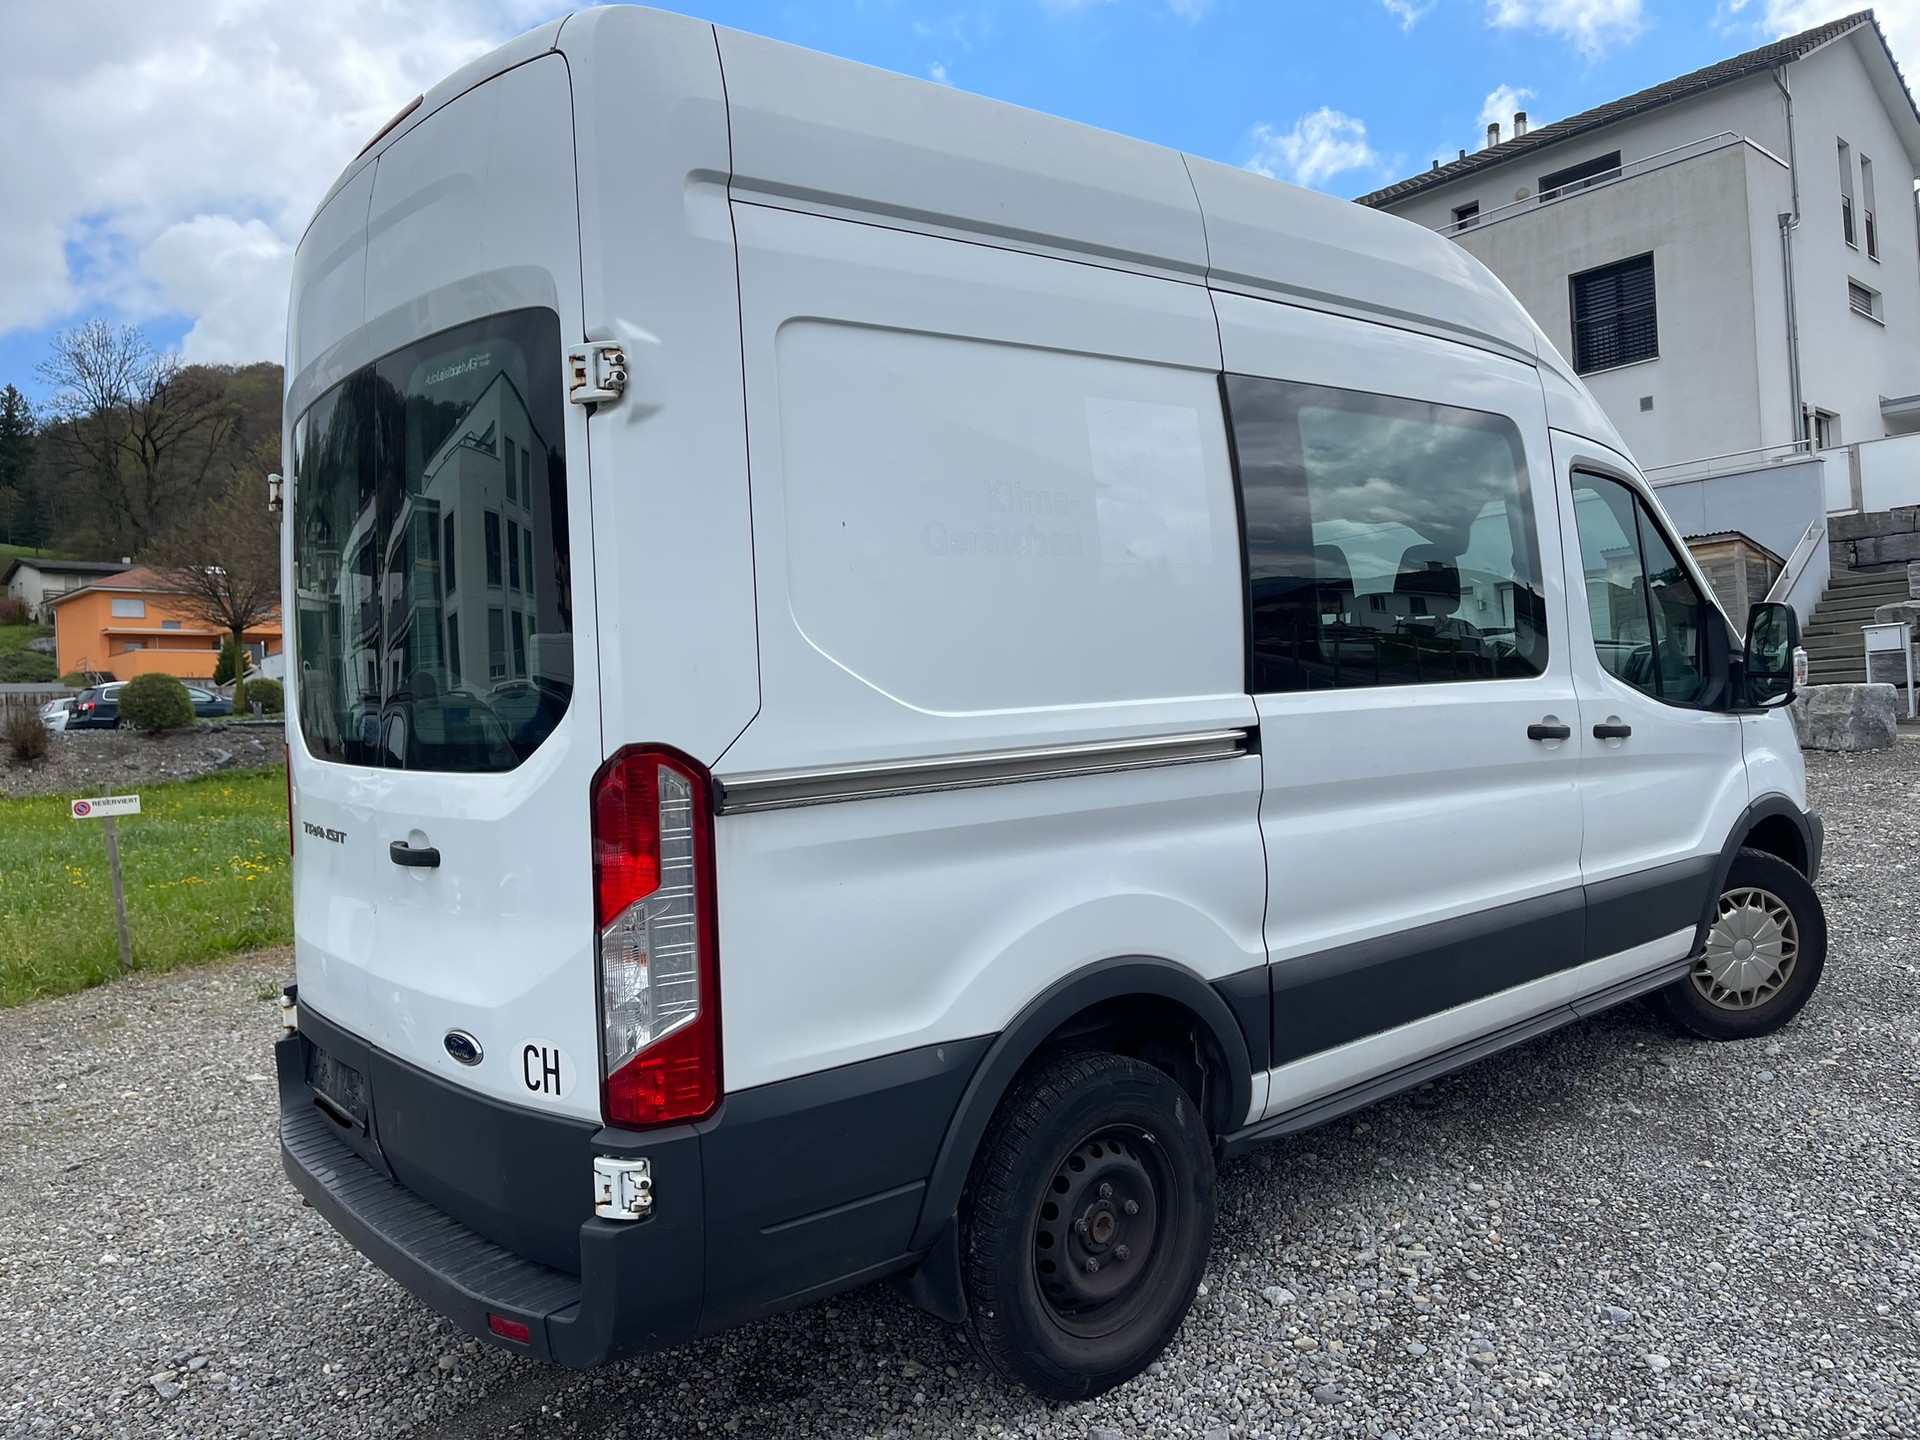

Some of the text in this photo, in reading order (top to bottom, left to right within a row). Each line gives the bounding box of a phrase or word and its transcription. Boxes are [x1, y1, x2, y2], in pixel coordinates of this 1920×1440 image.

[983, 479, 1080, 514] Klima-
[91, 797, 138, 807] RESERVIERT
[302, 821, 347, 845] TRANSIT
[449, 1037, 471, 1060] Ford
[523, 1044, 561, 1096] CH
